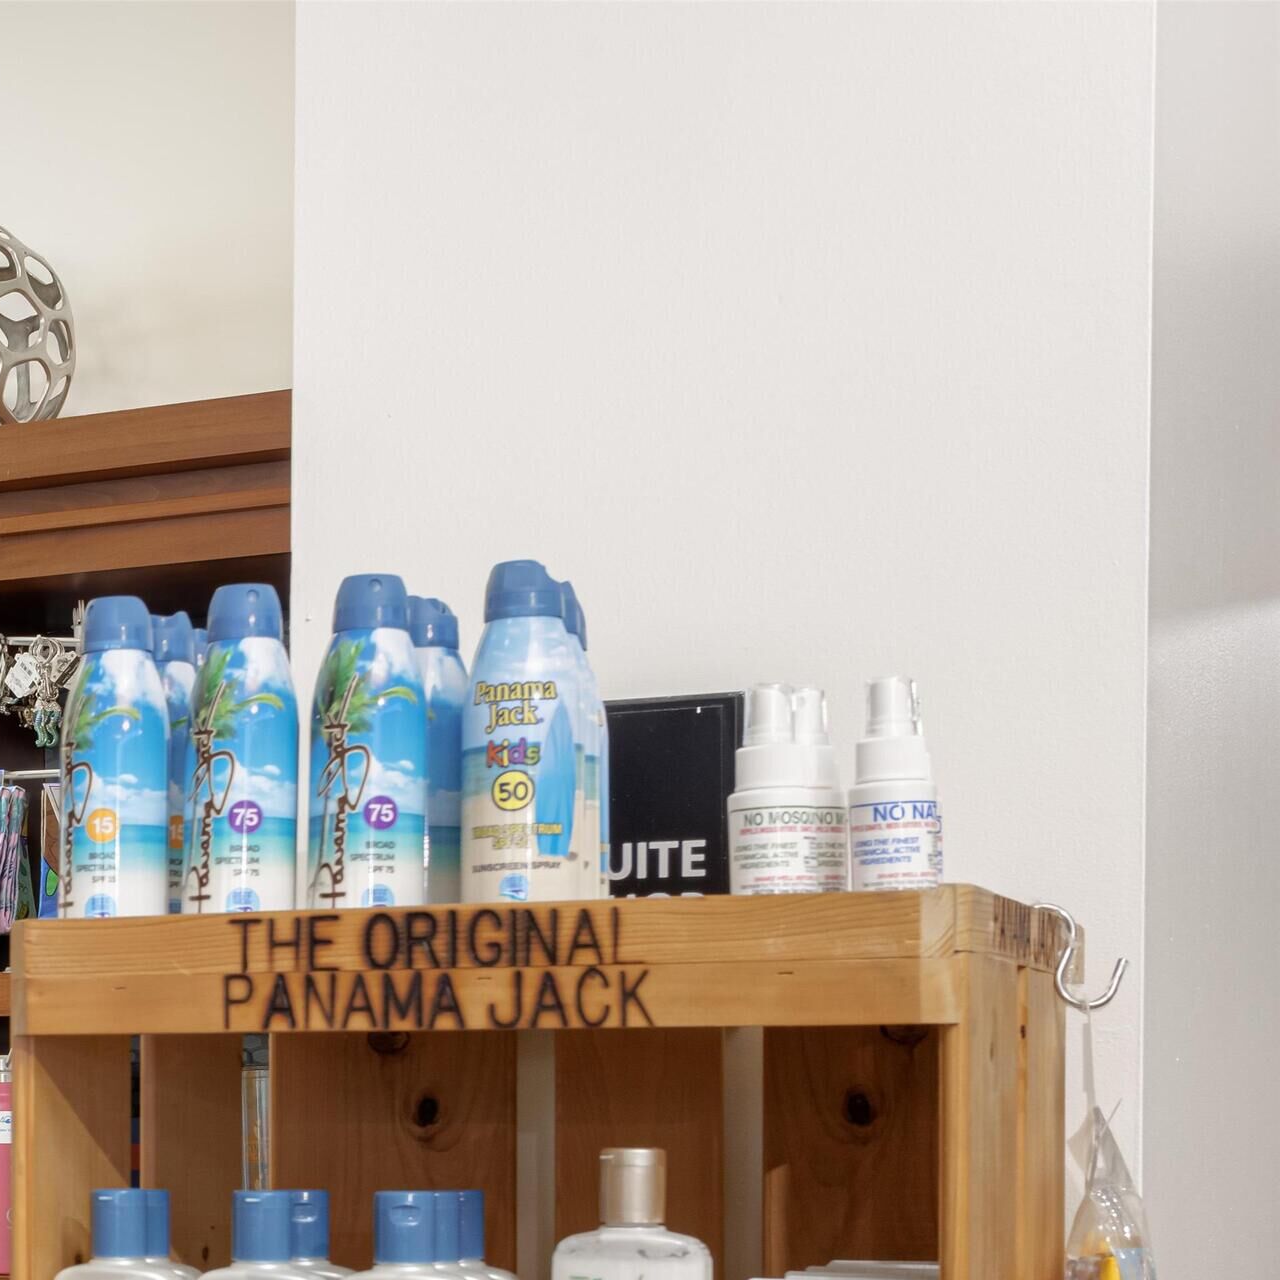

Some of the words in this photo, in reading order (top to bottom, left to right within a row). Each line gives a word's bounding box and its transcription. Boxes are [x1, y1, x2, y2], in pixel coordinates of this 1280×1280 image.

[474, 681, 558, 706] Panama
[485, 700, 538, 734] Jack
[498, 781, 528, 802] 50
[232, 808, 259, 827] 75
[368, 804, 394, 822] 75
[872, 803, 904, 822] NO
[92, 816, 114, 834] 15
[227, 915, 341, 973] THE
[363, 905, 646, 972] ORIGINAL
[222, 970, 466, 1032] PANAMA
[487, 965, 655, 1030] JACK
